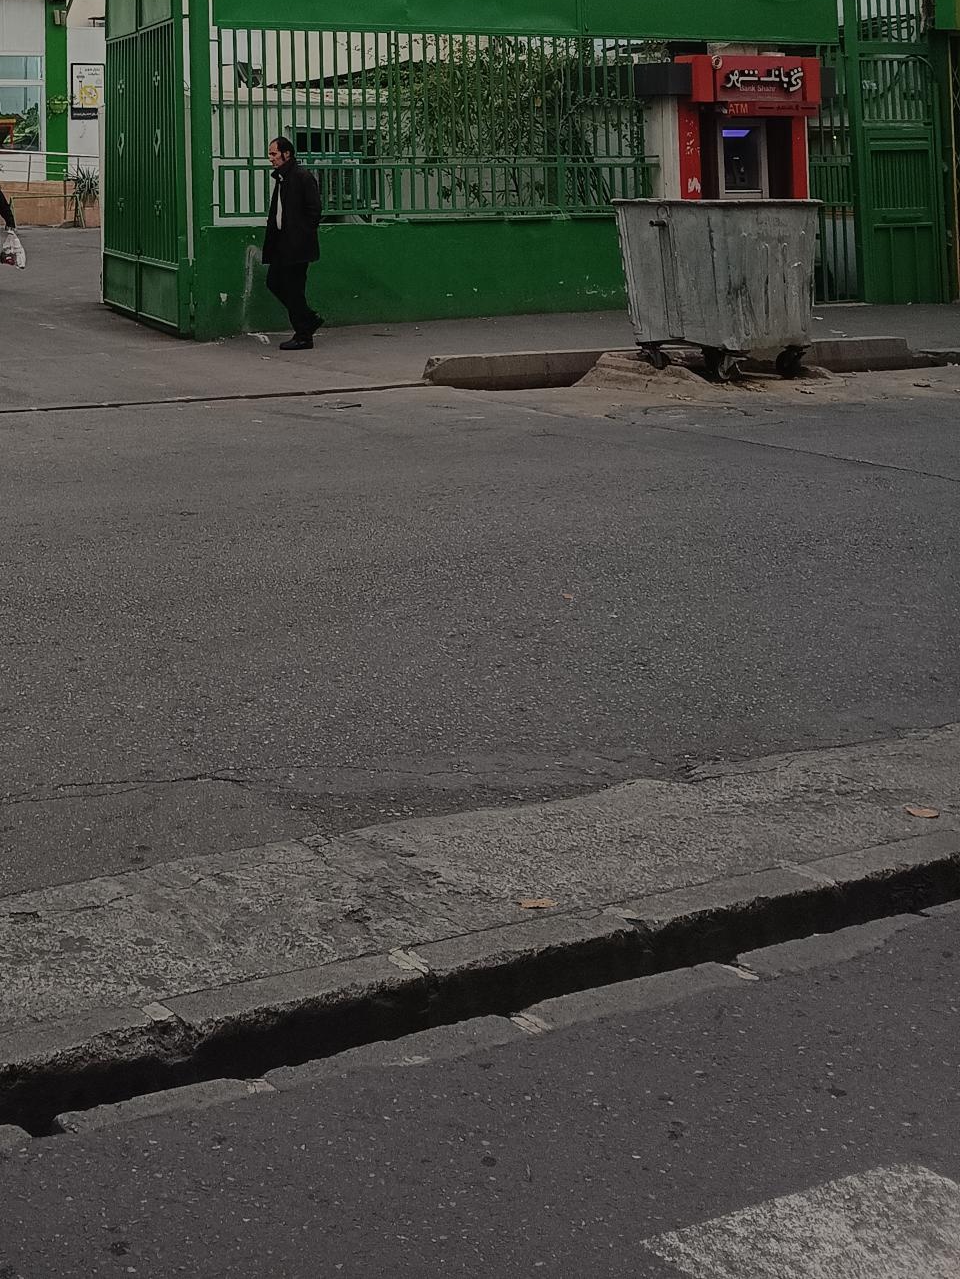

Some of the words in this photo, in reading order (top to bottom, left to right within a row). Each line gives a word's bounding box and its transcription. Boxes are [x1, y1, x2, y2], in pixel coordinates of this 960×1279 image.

[725, 69, 759, 88] شهر
[760, 67, 789, 88] بانک
[728, 103, 749, 115] ATM
